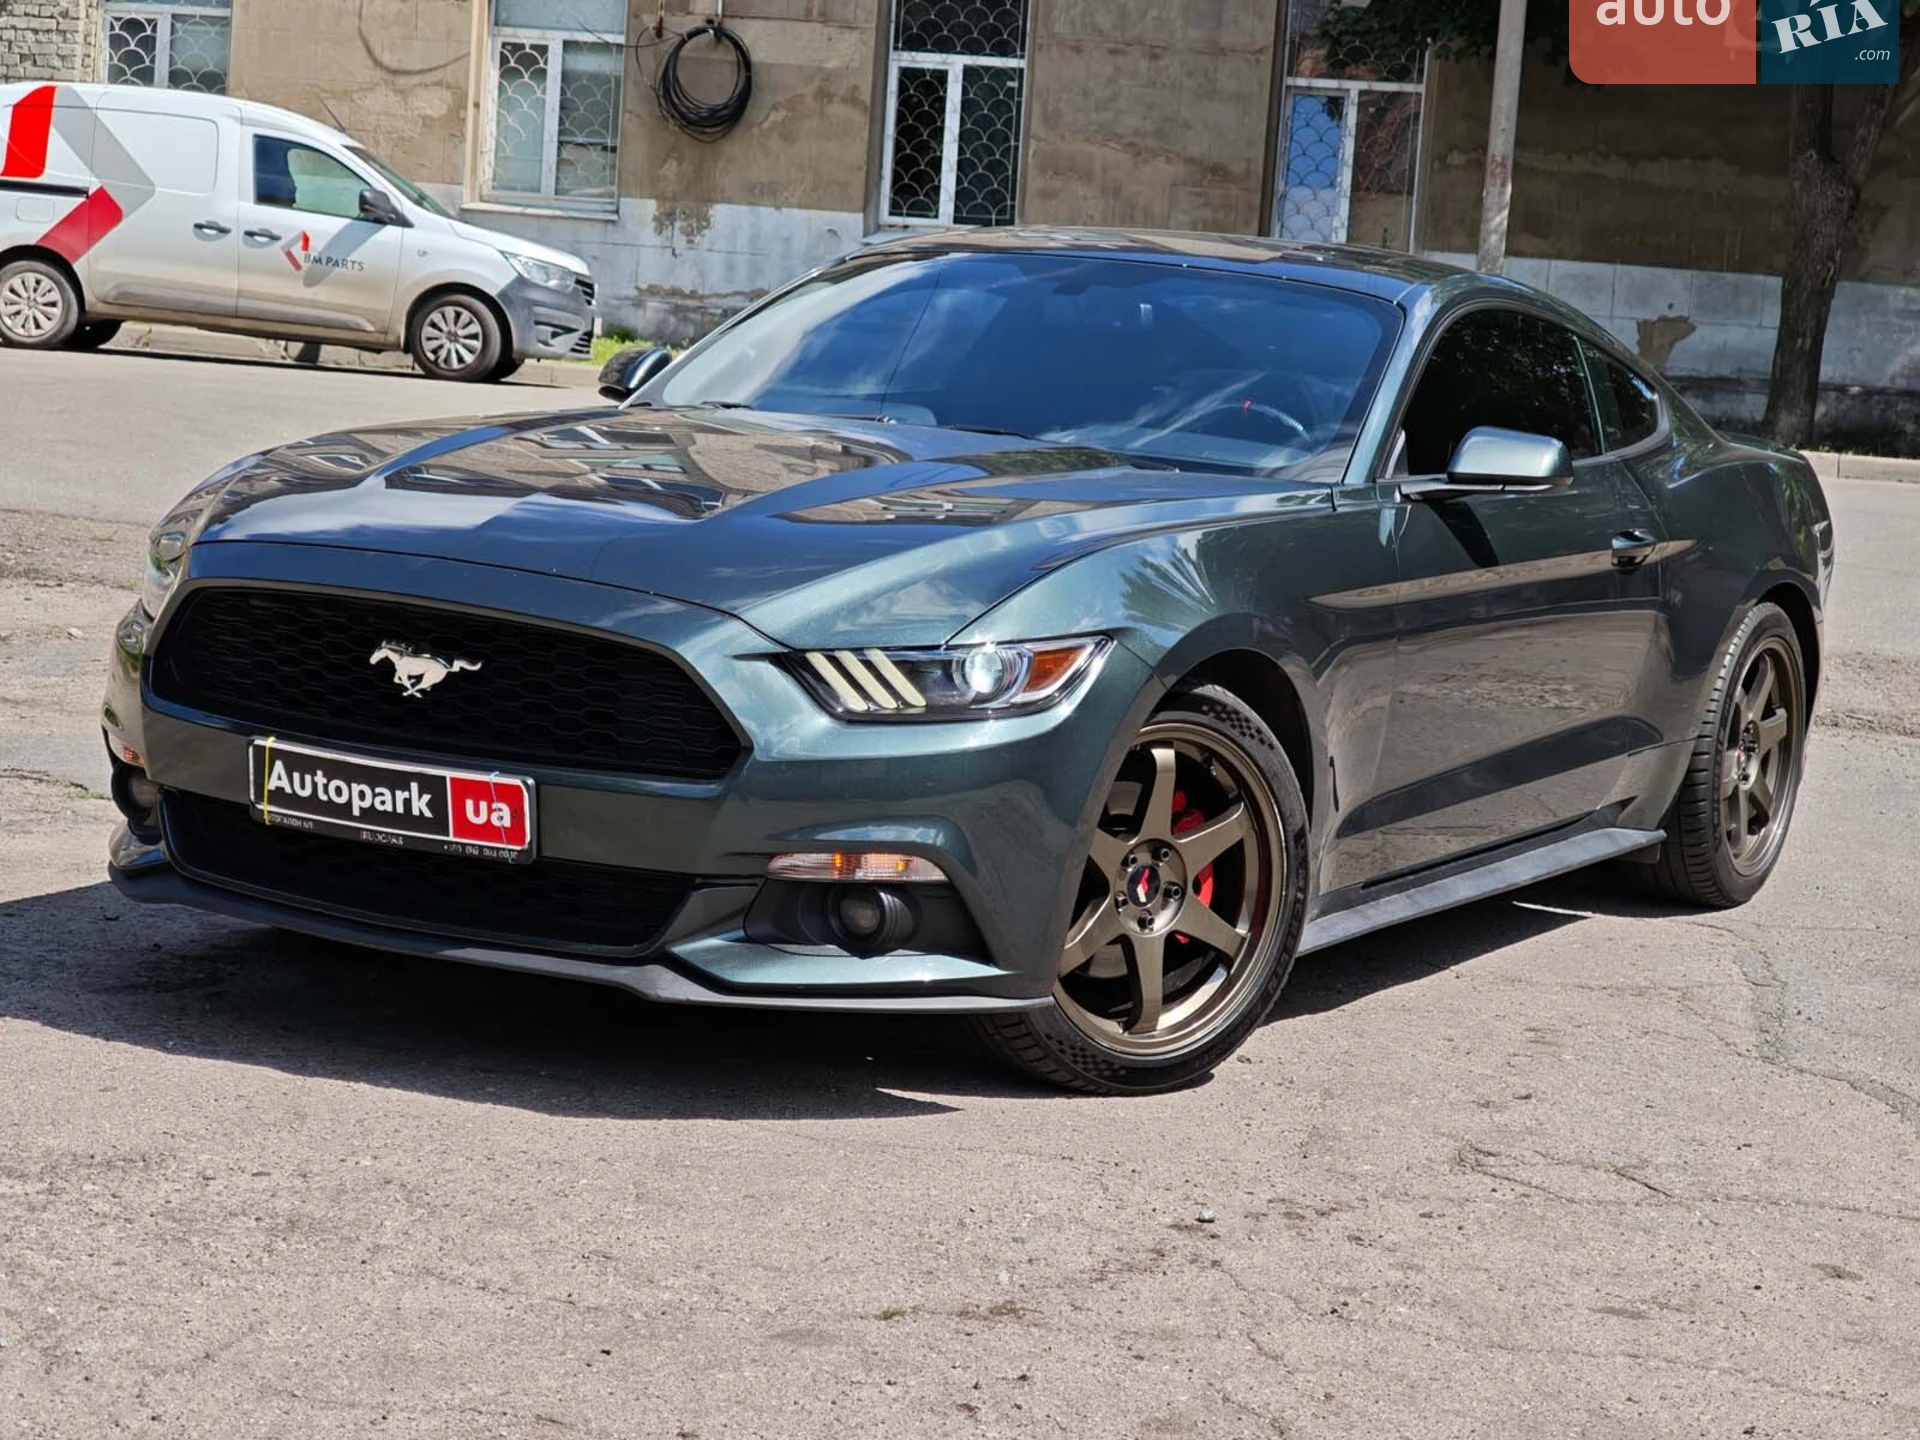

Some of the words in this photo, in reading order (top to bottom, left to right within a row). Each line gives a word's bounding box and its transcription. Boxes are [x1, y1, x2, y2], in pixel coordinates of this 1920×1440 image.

[304, 252, 323, 265] BM
[325, 256, 365, 271] PARTS
[268, 760, 433, 818] Autopark
[465, 799, 511, 828] ua
